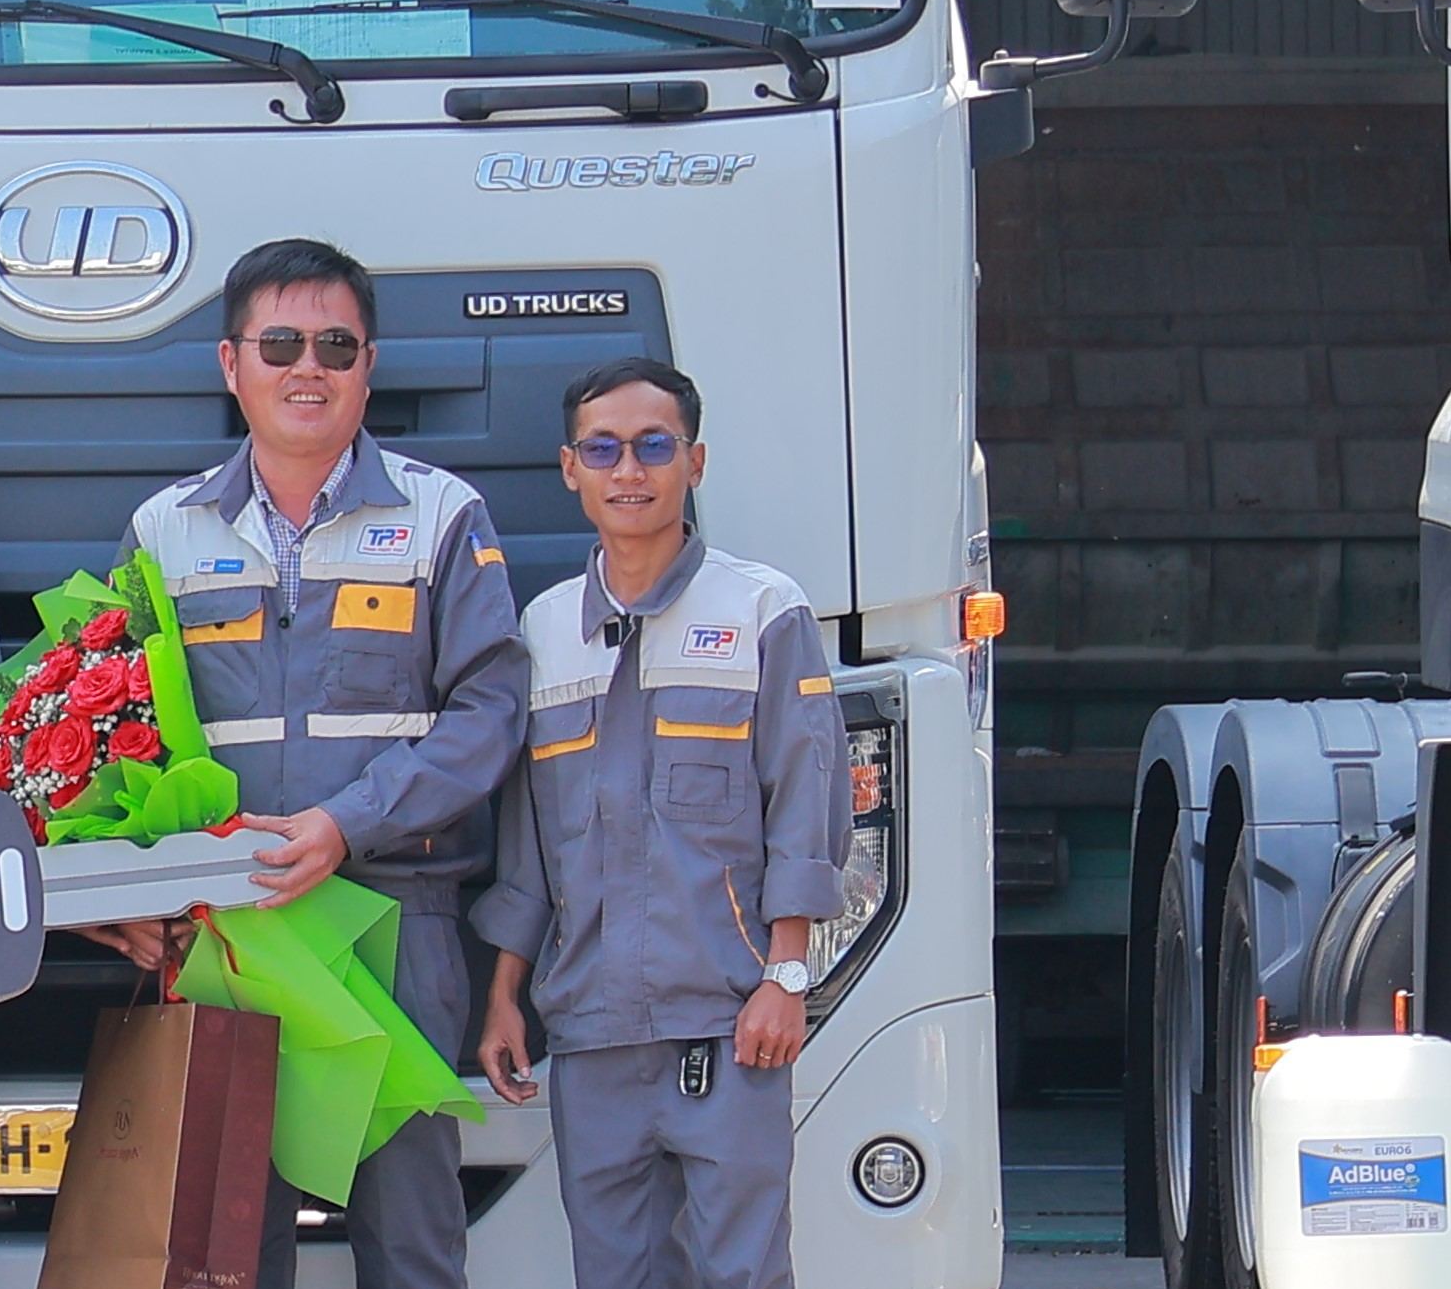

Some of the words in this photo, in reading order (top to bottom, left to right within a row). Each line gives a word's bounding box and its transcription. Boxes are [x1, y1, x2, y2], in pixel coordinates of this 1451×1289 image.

[475, 150, 757, 192] Quester
[467, 294, 507, 317] UD
[512, 292, 626, 314] TRUCKS
[368, 528, 410, 546] TPP
[692, 629, 735, 649] TPP
